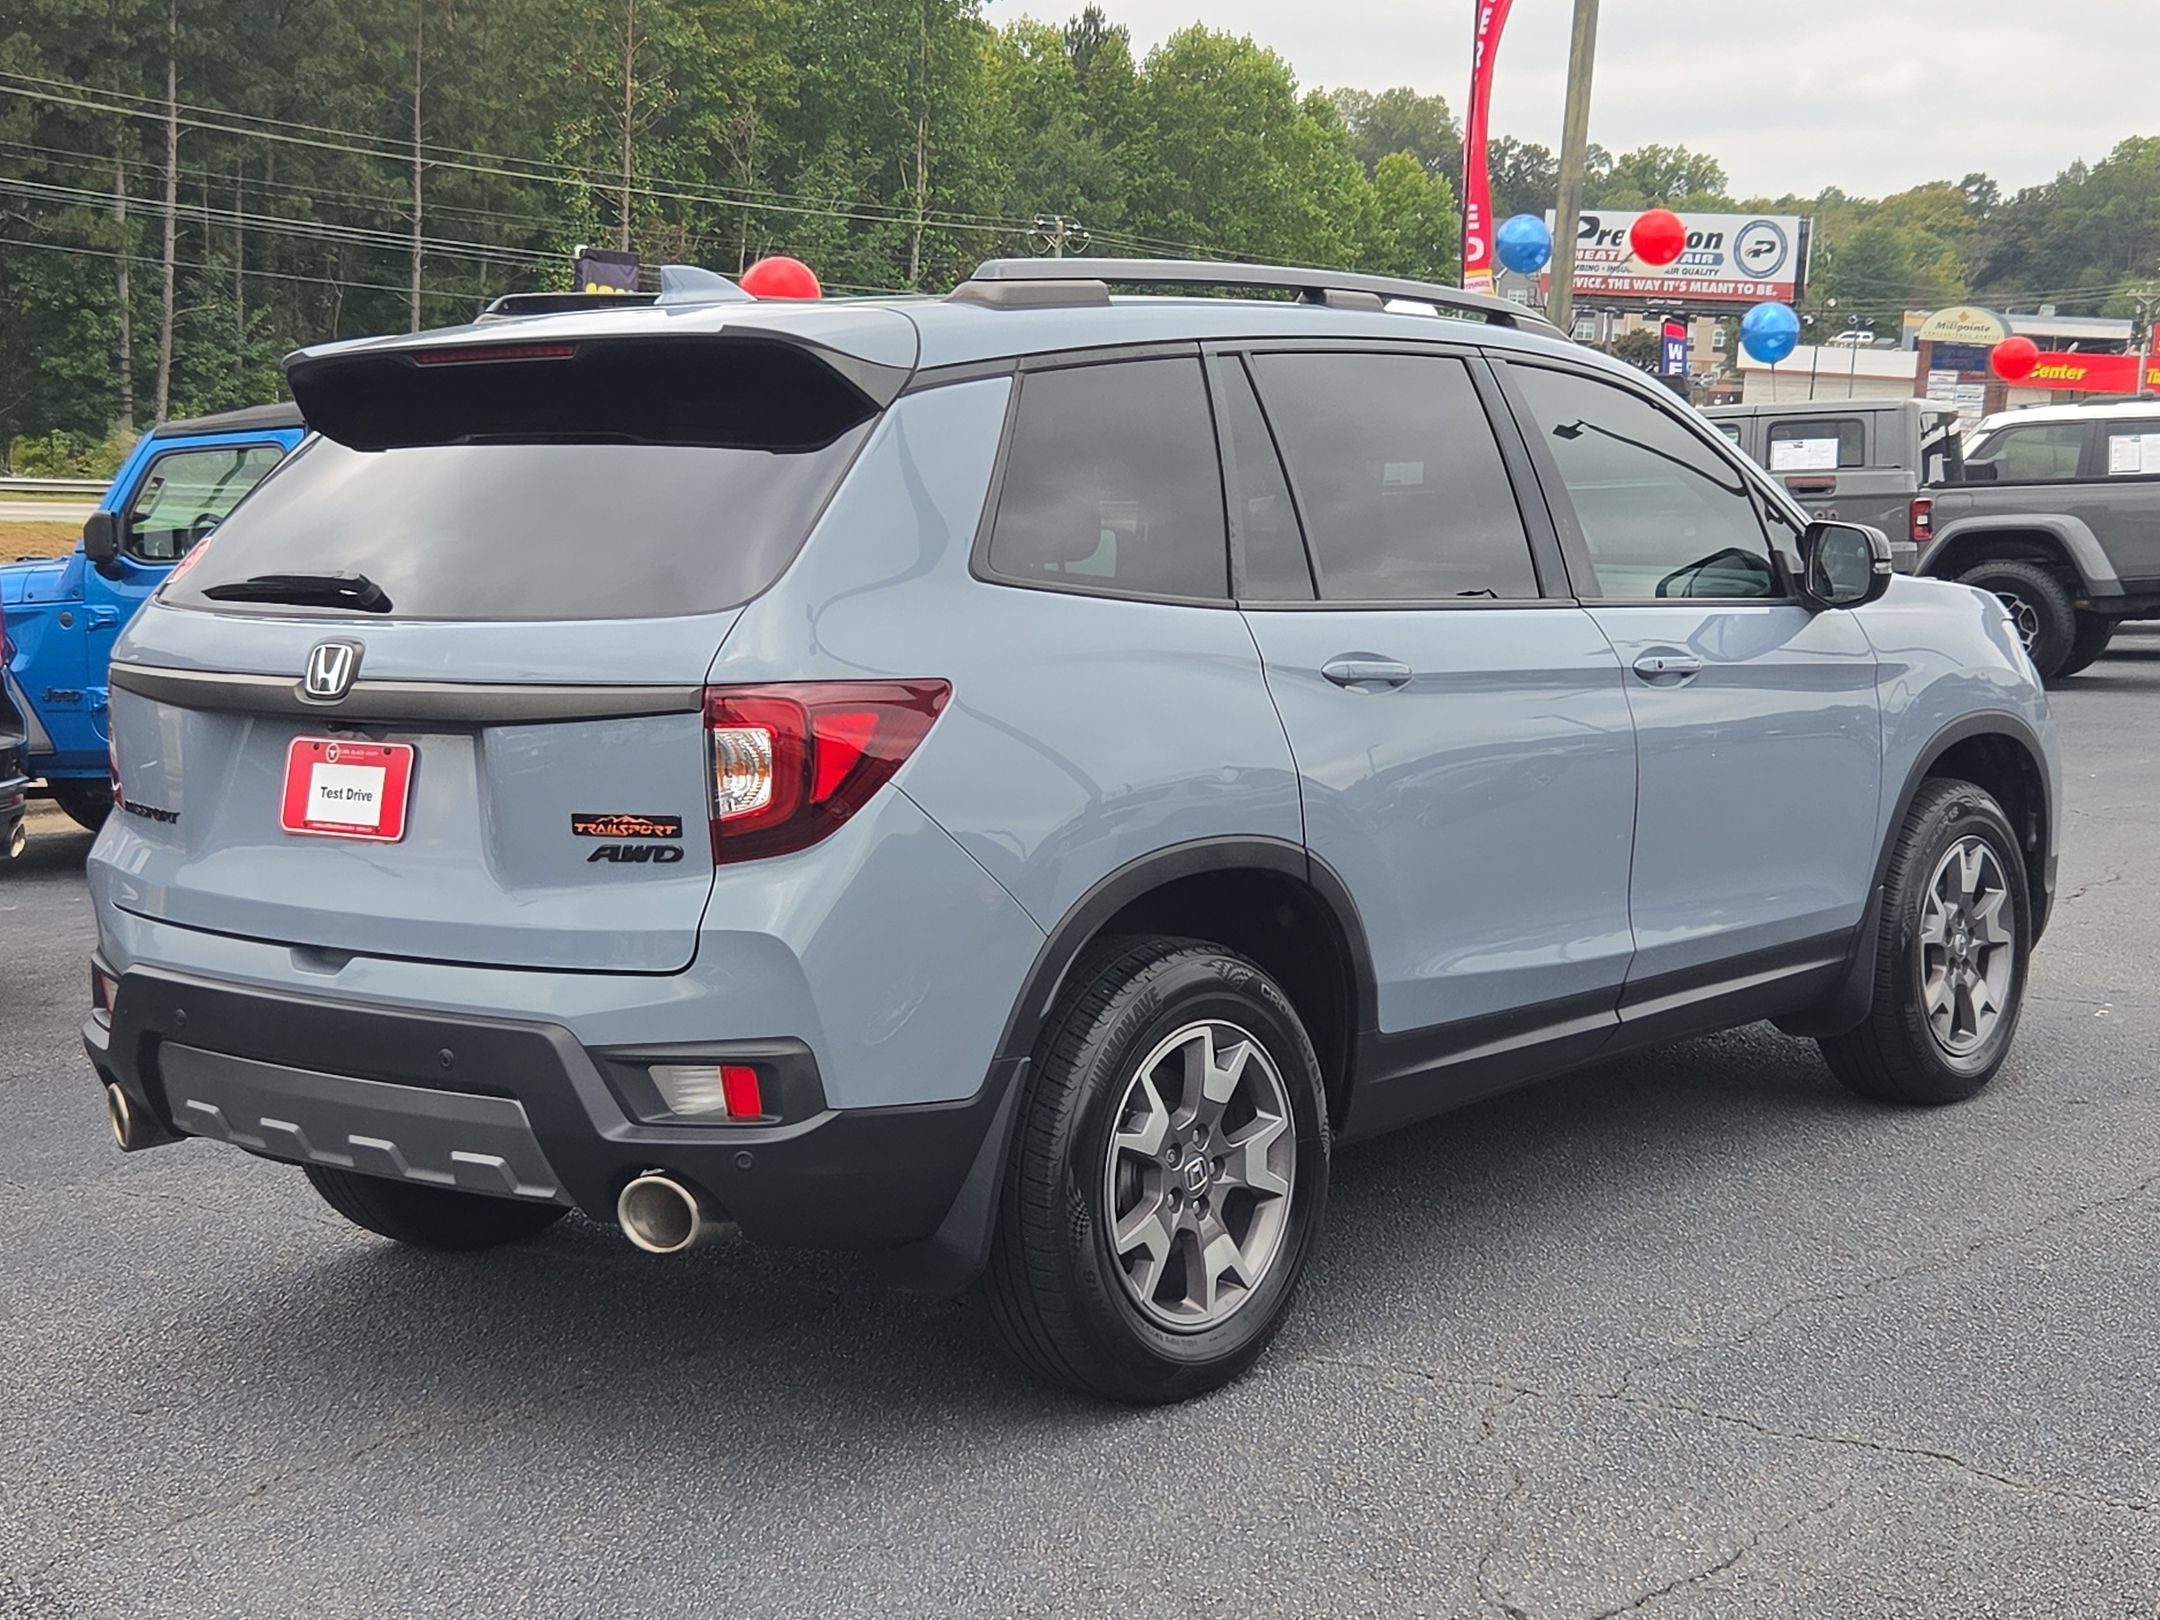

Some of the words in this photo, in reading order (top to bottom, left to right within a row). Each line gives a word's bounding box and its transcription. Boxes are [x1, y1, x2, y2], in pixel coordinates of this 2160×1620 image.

[1578, 216, 1724, 250] Preon
[1680, 253, 1714, 264] AIR
[1682, 268, 1720, 276] QUALITY
[1608, 279, 1630, 290] THE
[1632, 279, 1660, 291] WAY
[1663, 280, 1687, 292] IT'S
[1689, 281, 1735, 294] MEANT
[1737, 283, 1754, 295] TO
[1756, 283, 1777, 296] BE.
[1935, 321, 1991, 332] Millpointe
[320, 786, 344, 800] Test
[346, 788, 373, 802] Drive
[574, 822, 678, 837] TRAILSPORT
[586, 844, 684, 863] AWD
